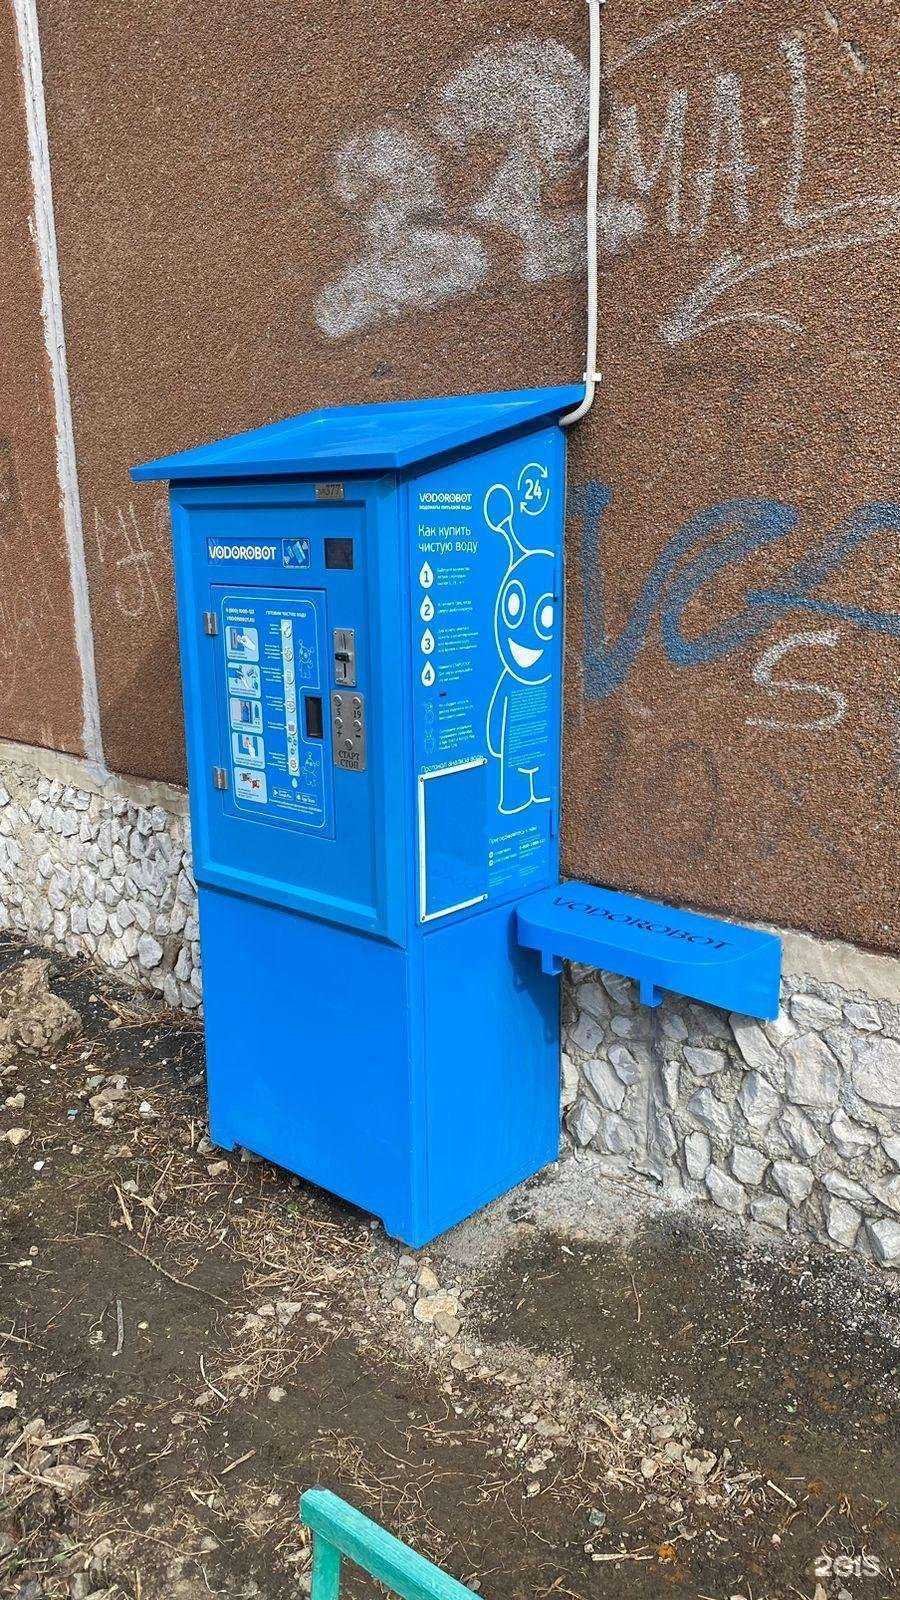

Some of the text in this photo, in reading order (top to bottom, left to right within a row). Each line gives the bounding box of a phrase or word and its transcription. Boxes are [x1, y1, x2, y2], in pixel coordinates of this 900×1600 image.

[524, 478, 543, 500] 24
[419, 492, 473, 503] VODOROBOT
[418, 524, 472, 540] Как купить
[208, 545, 277, 561] VODOROBOT
[418, 540, 479, 554] чистую воду
[422, 570, 431, 584] 1
[424, 603, 431, 616] 2
[424, 638, 431, 651] 3
[424, 669, 432, 682] 4
[338, 749, 361, 762] СТАРТ
[339, 759, 360, 770] СТОП
[552, 895, 734, 951] VODOROBOT
